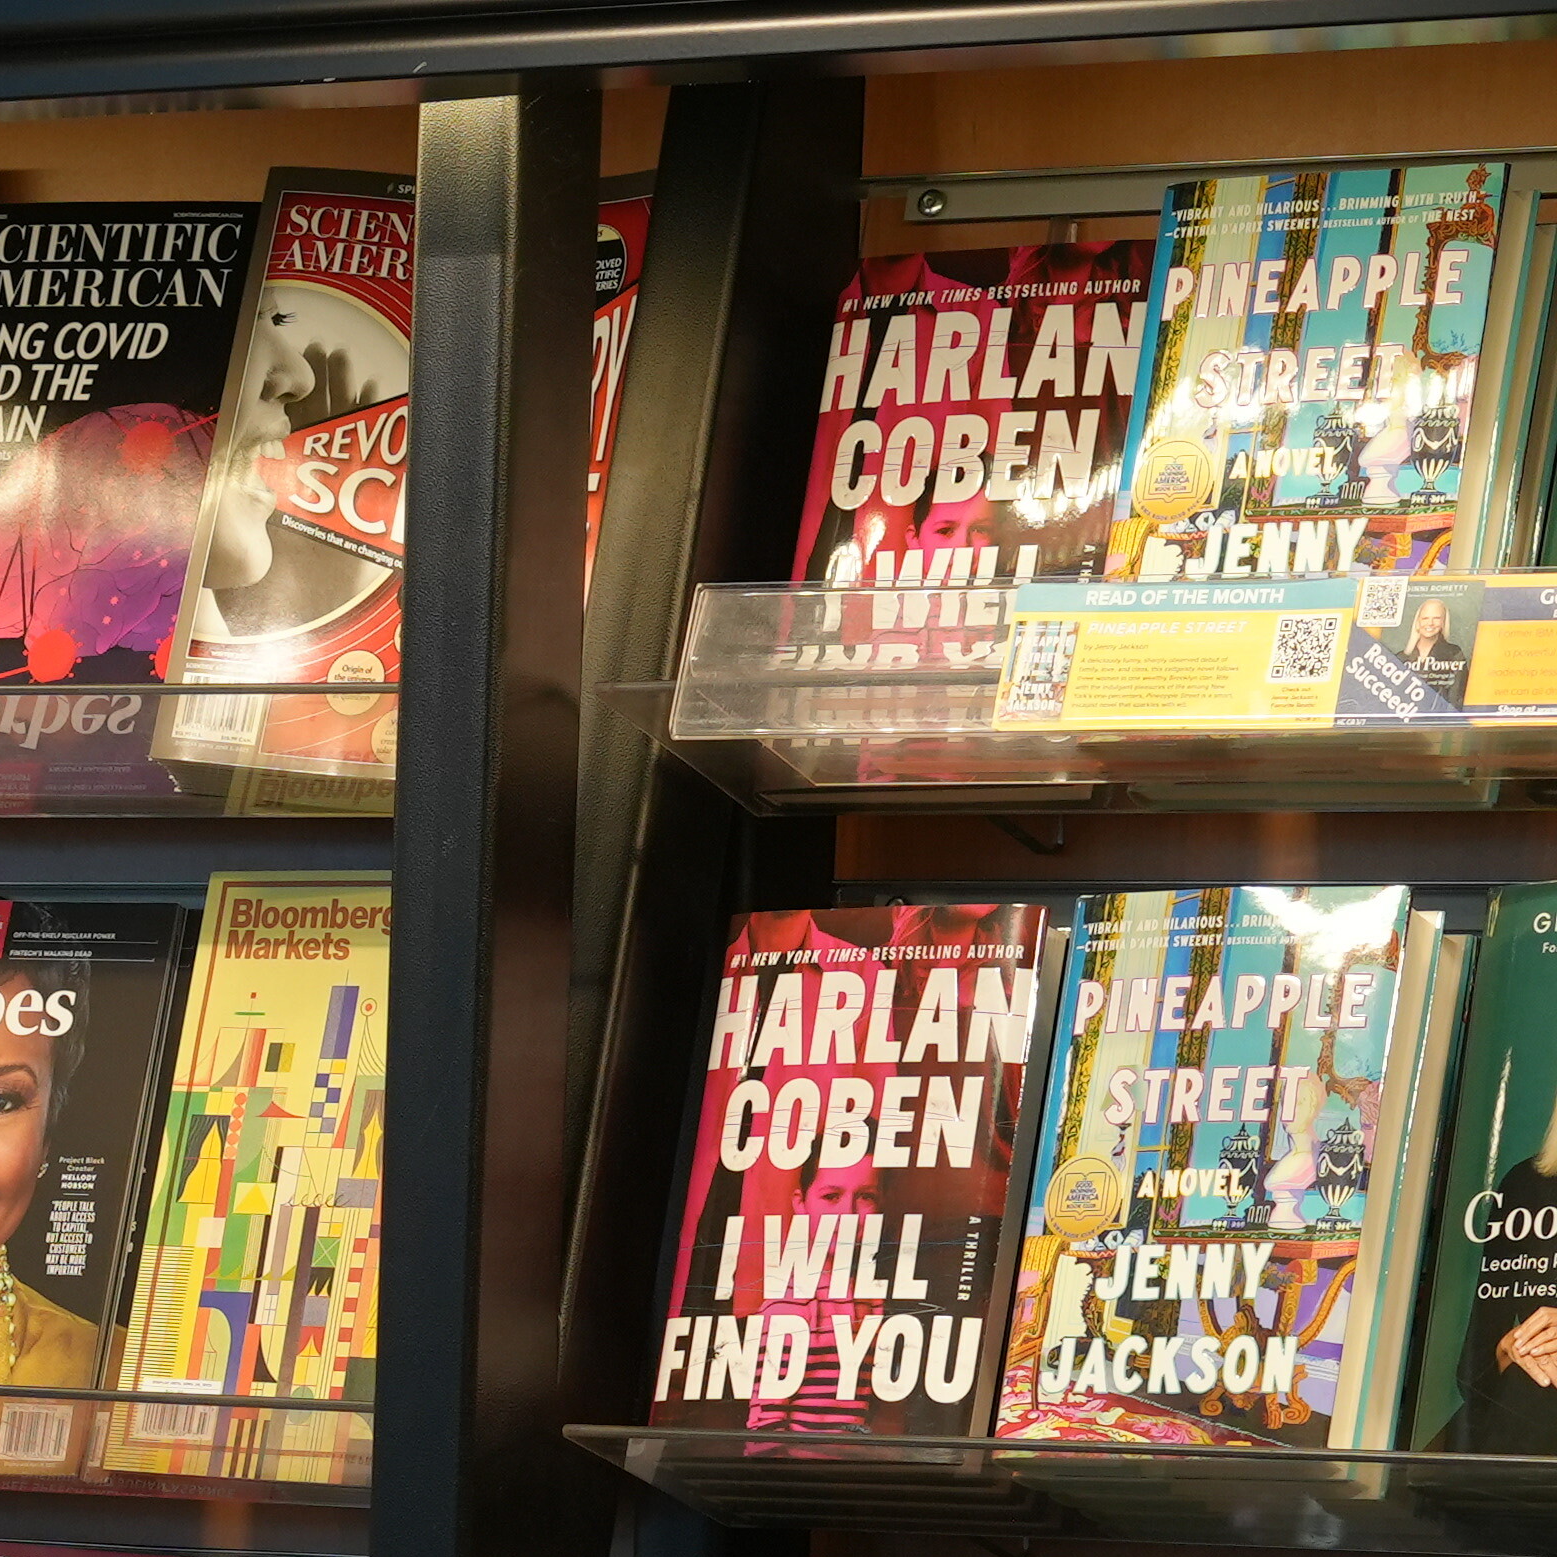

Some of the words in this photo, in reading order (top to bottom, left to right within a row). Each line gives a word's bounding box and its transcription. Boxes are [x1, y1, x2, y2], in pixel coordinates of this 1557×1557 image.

[1086, 589, 1137, 606] READ
[1141, 589, 1168, 605] OF
[1172, 589, 1208, 604] THE
[1212, 588, 1285, 604] MONTH
[709, 968, 1032, 1070] HARLAN
[1075, 975, 1375, 1036] PINEAPPLE
[720, 1076, 983, 1172] COBEN
[1105, 1065, 1310, 1127] STREET
